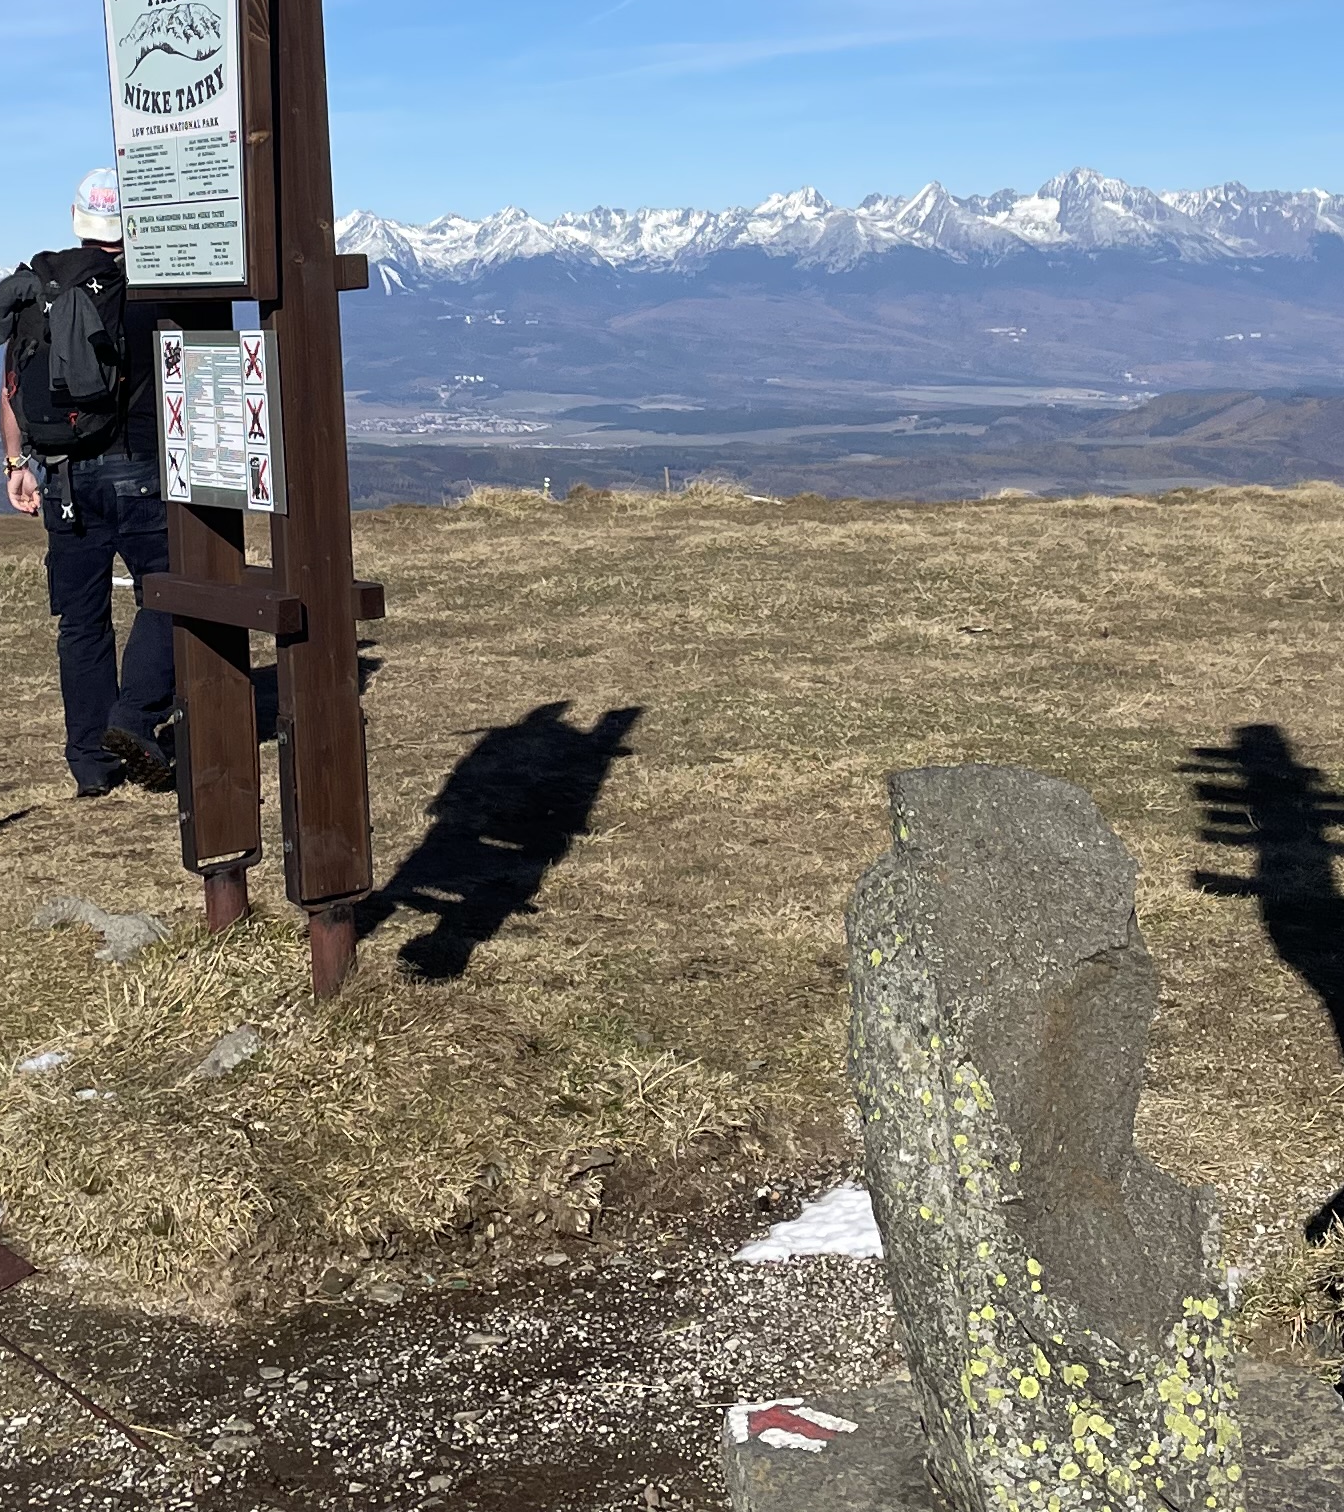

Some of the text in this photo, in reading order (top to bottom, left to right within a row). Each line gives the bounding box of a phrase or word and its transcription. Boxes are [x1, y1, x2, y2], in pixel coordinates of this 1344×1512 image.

[124, 63, 224, 115] NÍZKE TATRY
[169, 119, 201, 133] NATIONAL
[201, 116, 219, 128] PARK
